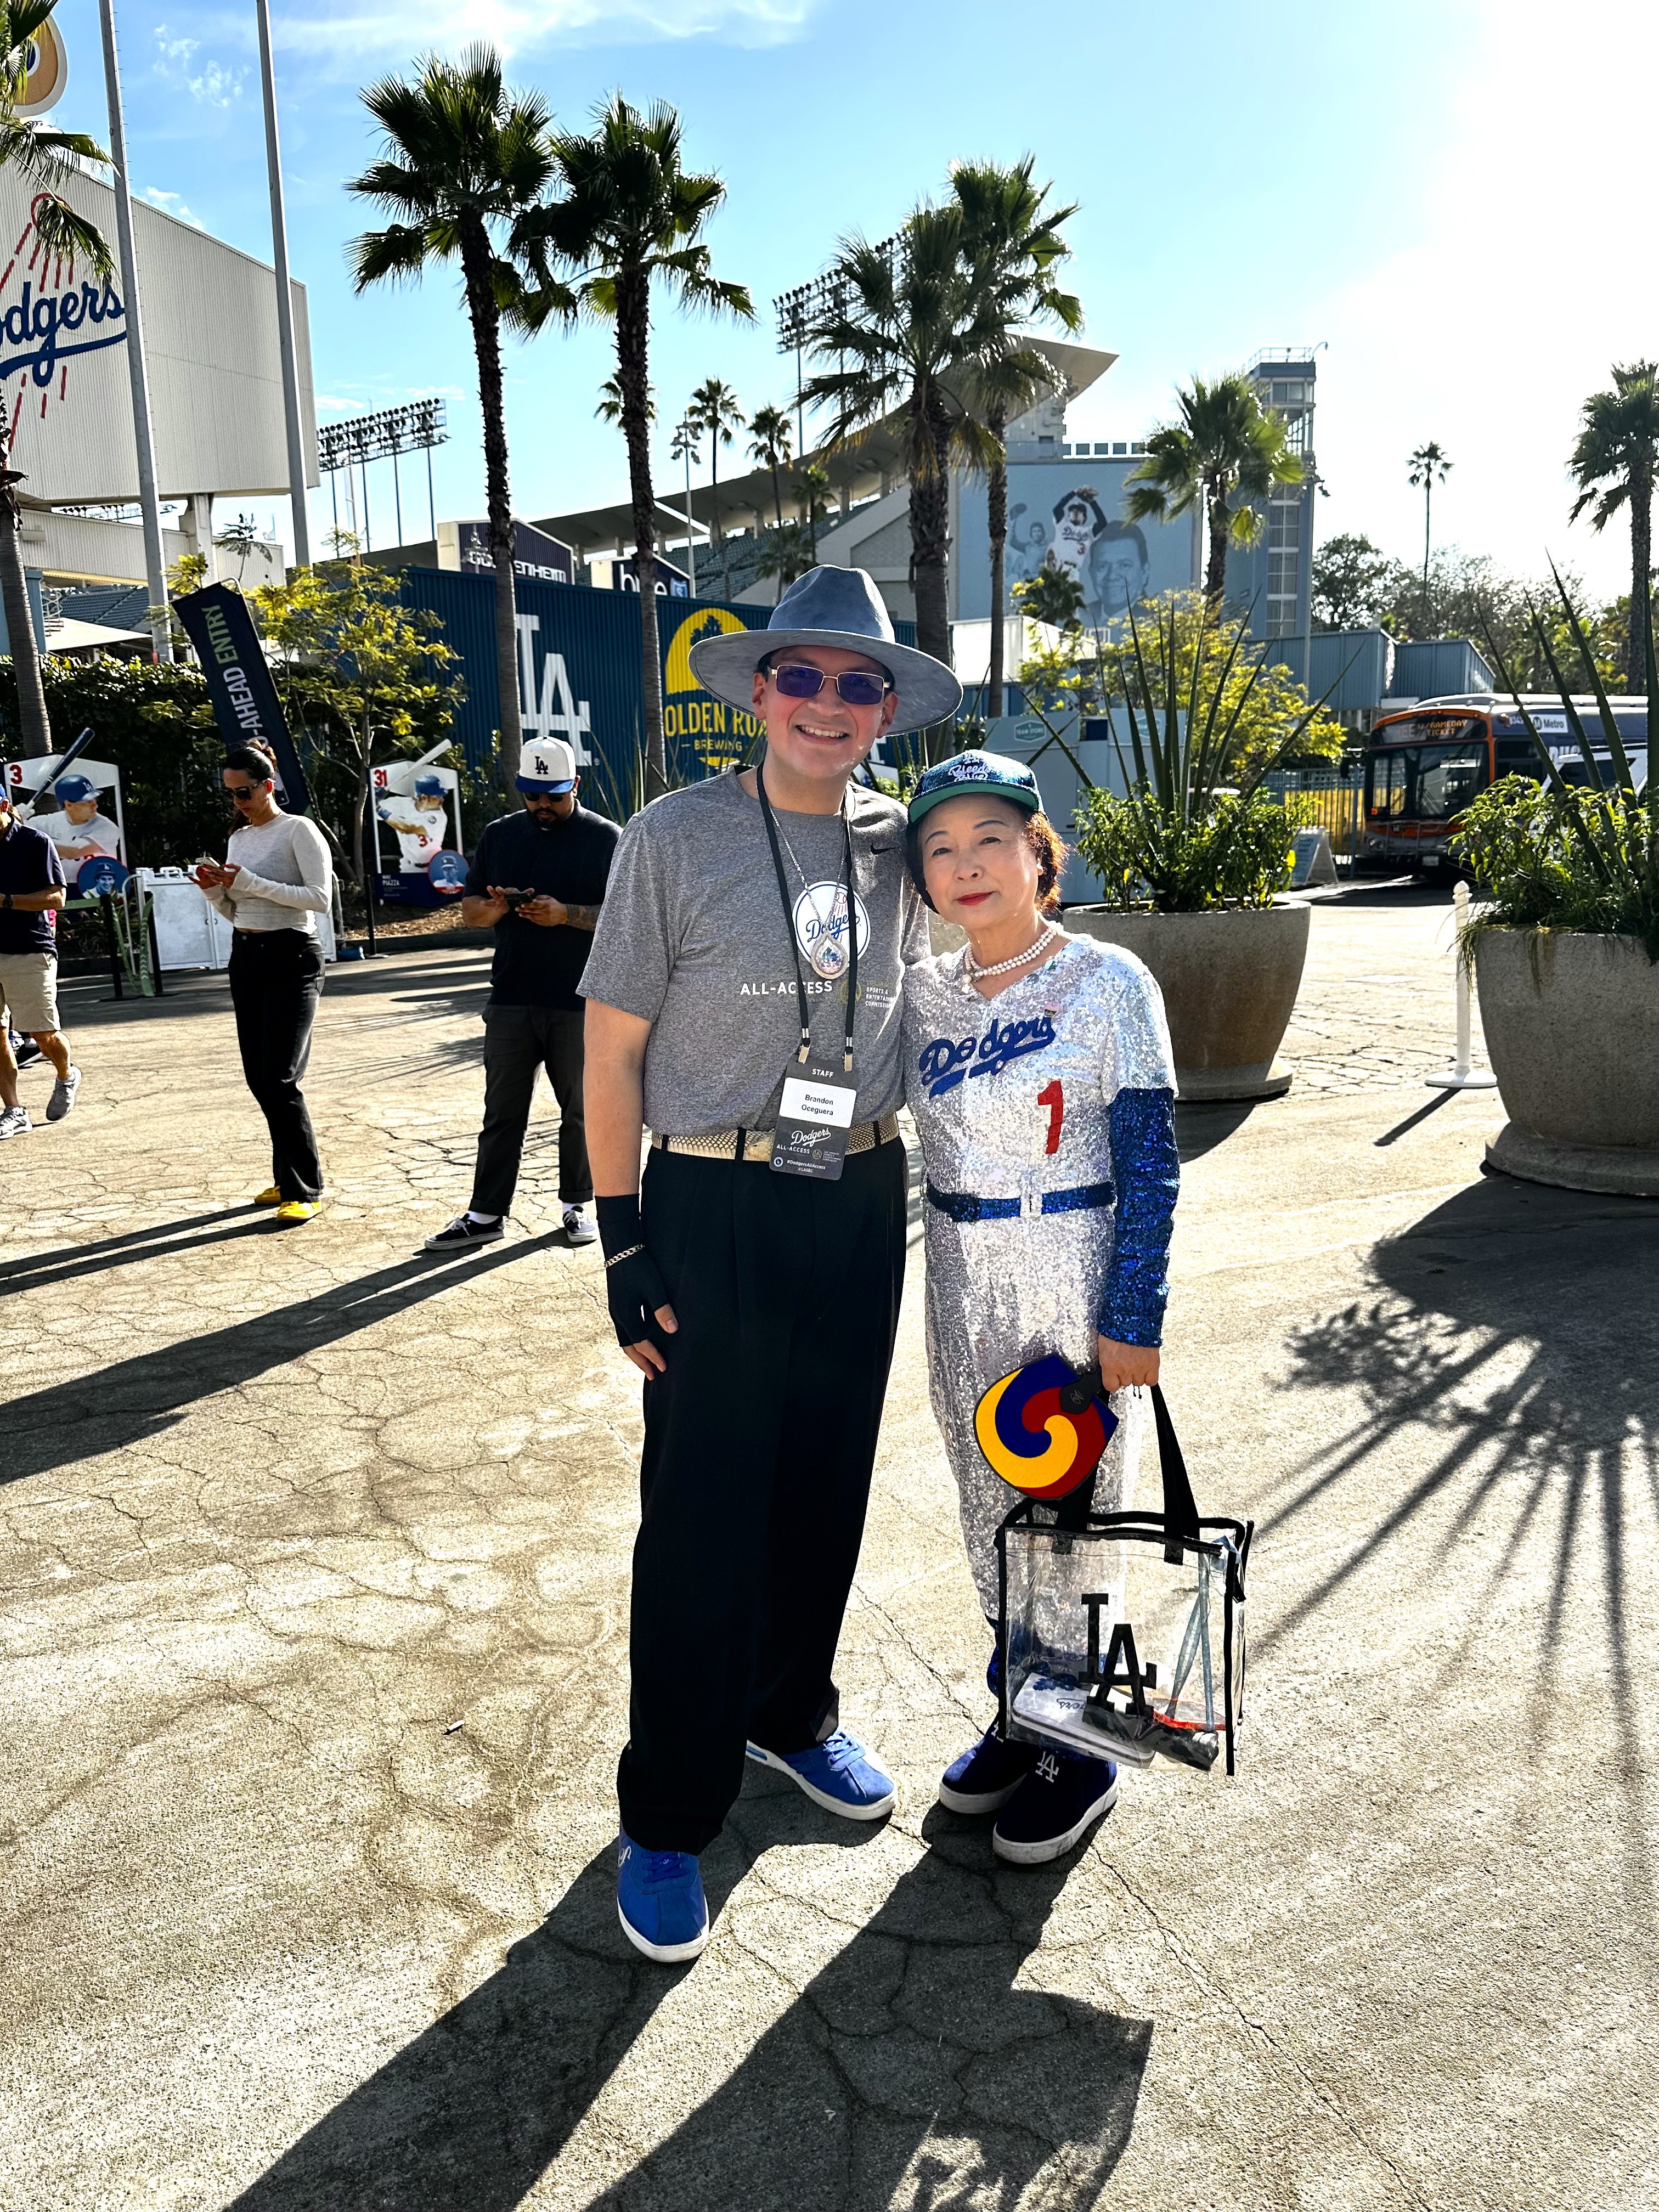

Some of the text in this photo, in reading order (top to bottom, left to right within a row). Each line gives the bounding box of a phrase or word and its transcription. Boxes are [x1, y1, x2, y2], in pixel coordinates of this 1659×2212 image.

[0, 281, 125, 387] dgers
[470, 551, 567, 583] GUENHEIM
[201, 605, 239, 665] ENTRY
[515, 613, 592, 767] LA
[664, 702, 725, 737] OLDEN
[1543, 719, 1564, 729] Metro
[693, 739, 743, 752] BREWING
[10, 764, 23, 785] 3
[535, 756, 549, 775] LA
[374, 769, 387, 787] 31
[740, 980, 833, 995] ALL-ACESS
[919, 1018, 1057, 1092] Dodgers
[812, 1068, 834, 1078] STAFF
[805, 1094, 833, 1105] Brandon
[801, 1104, 833, 1116] Oceguera
[1037, 1080, 1064, 1154] 1
[791, 1127, 831, 1147] Dodgers
[776, 1144, 810, 1154] ALL-ACCESS
[787, 1160, 826, 1170] #DodgersAllAccess
[1078, 1593, 1157, 1716] LA
[1035, 1751, 1059, 1783] LA
